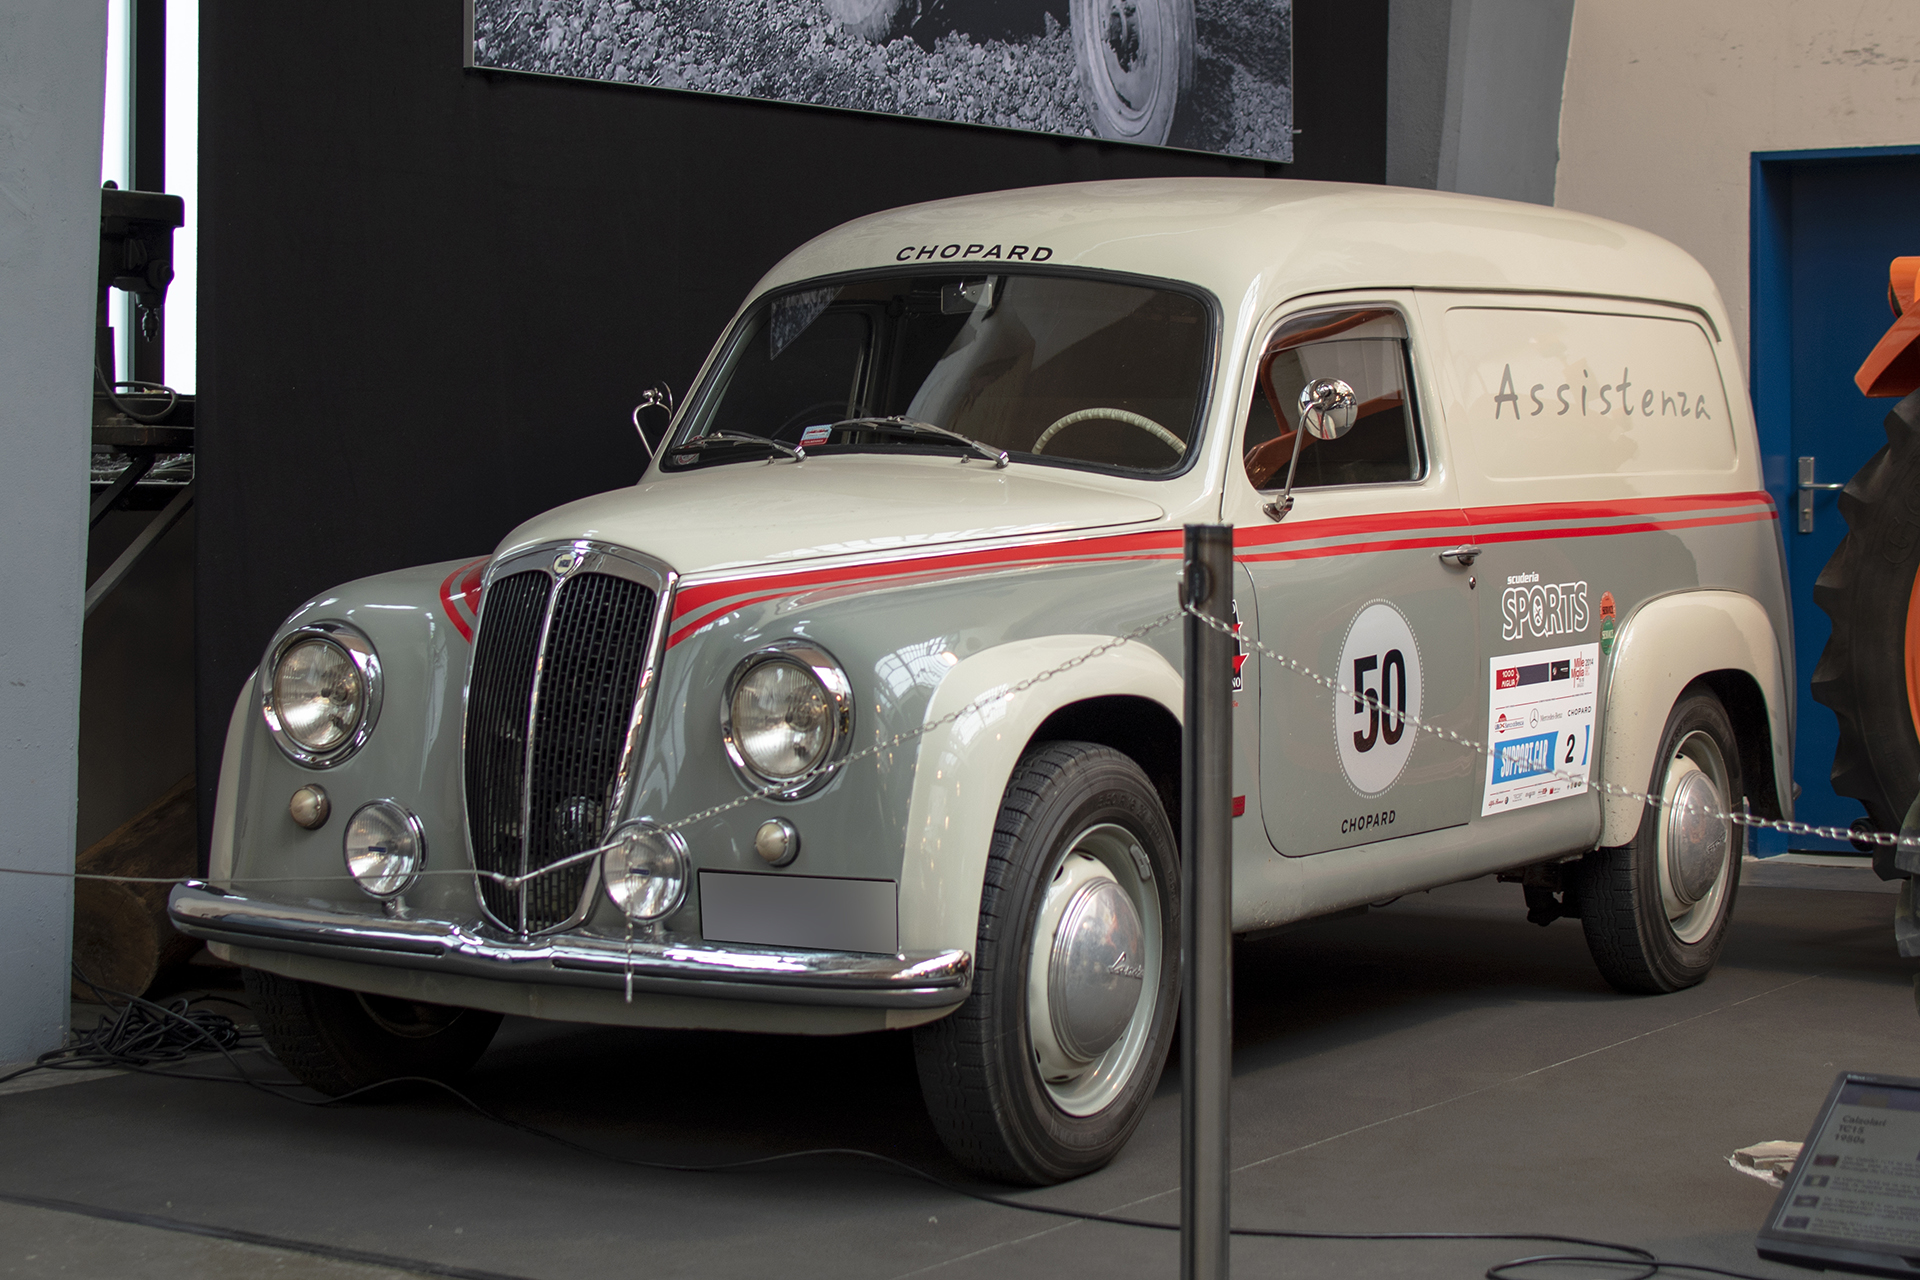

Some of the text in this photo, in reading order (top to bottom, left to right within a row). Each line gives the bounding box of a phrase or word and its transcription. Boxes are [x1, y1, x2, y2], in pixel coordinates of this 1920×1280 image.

[896, 244, 1053, 261] CHOPARD
[1494, 363, 1711, 420] Assistenza
[1507, 571, 1539, 585] scuderia
[1502, 580, 1590, 641] SPORTS
[1501, 678, 1516, 688] MIGLIA
[1502, 669, 1515, 678] 1000
[1353, 648, 1407, 754] 50
[1567, 706, 1592, 717] CHOPARD
[1500, 739, 1549, 778] SUPPORT CAR
[1565, 734, 1576, 764] 2
[1341, 810, 1396, 834] CHOPARD
